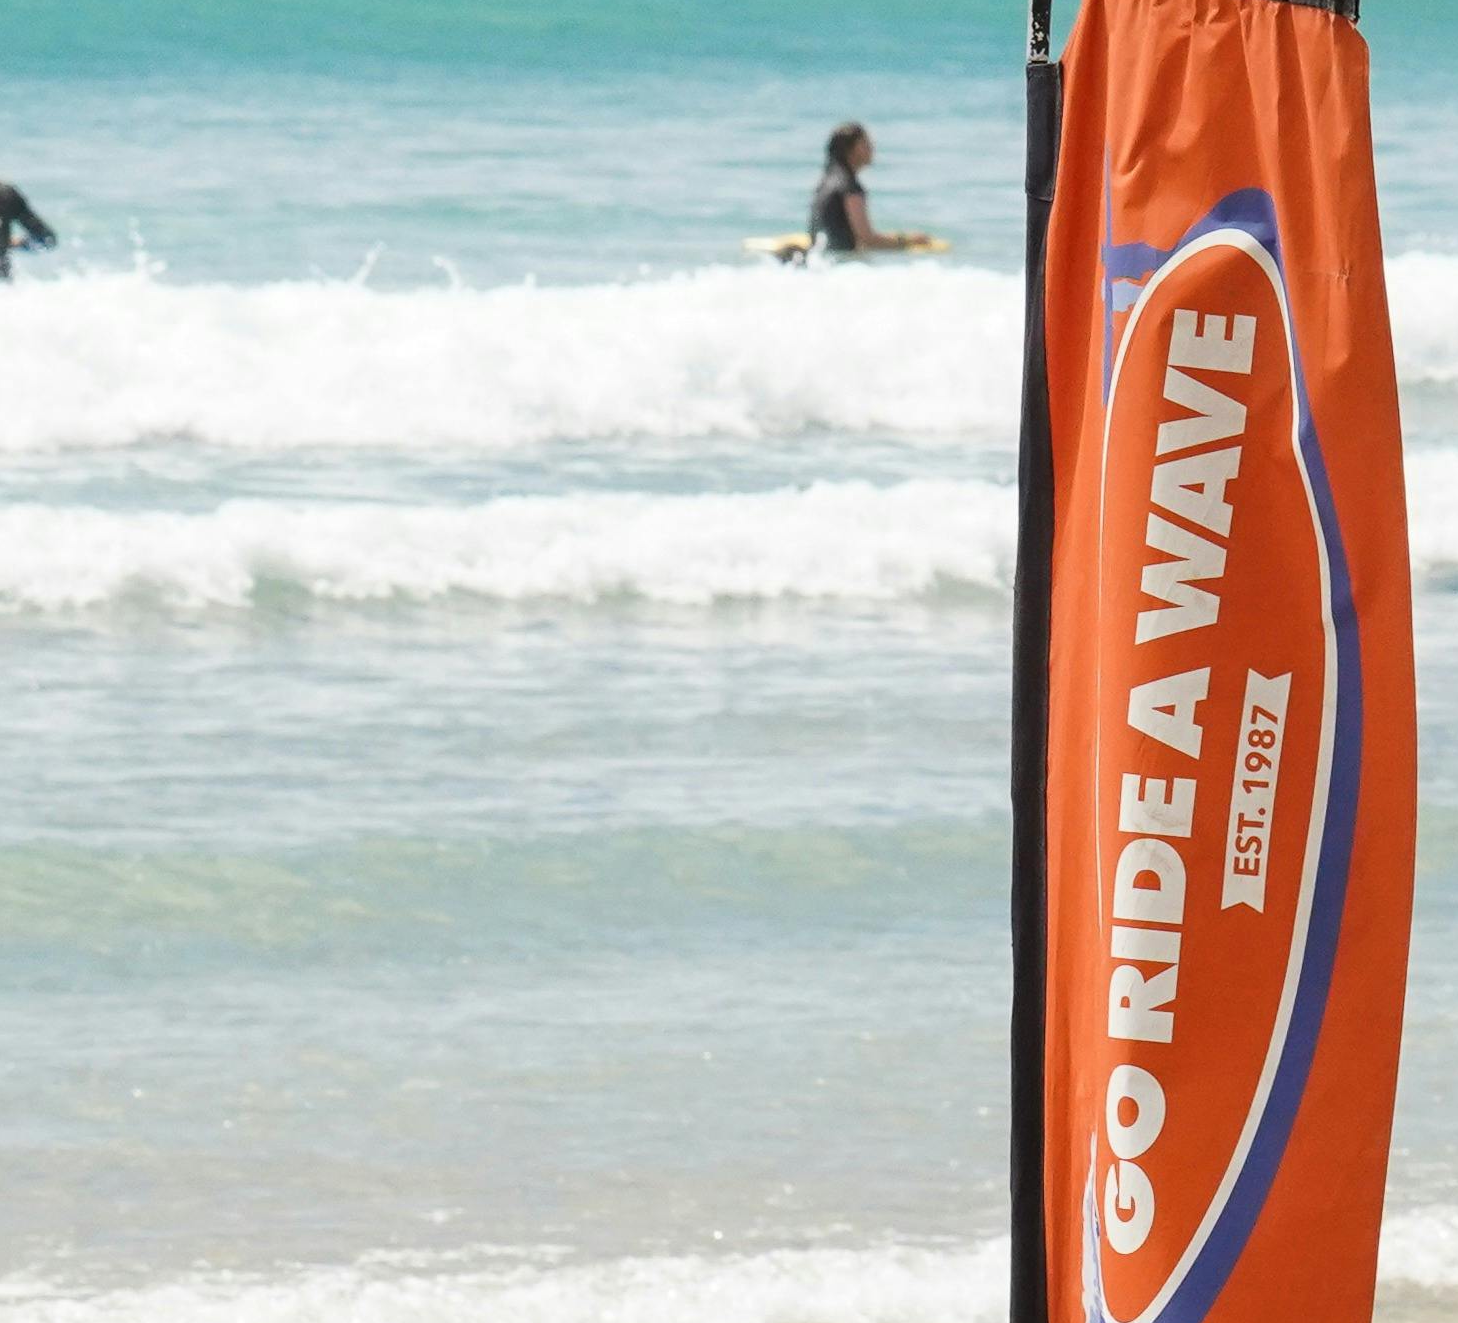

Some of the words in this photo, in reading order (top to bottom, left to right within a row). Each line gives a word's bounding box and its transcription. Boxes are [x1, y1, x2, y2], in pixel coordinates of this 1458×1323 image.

[1134, 308, 1258, 645] WAVE
[1127, 666, 1211, 760] A
[1242, 704, 1279, 794] 1987
[1107, 772, 1197, 1044] RIDE
[1233, 810, 1267, 877] EST.
[1103, 1063, 1166, 1256] GO
